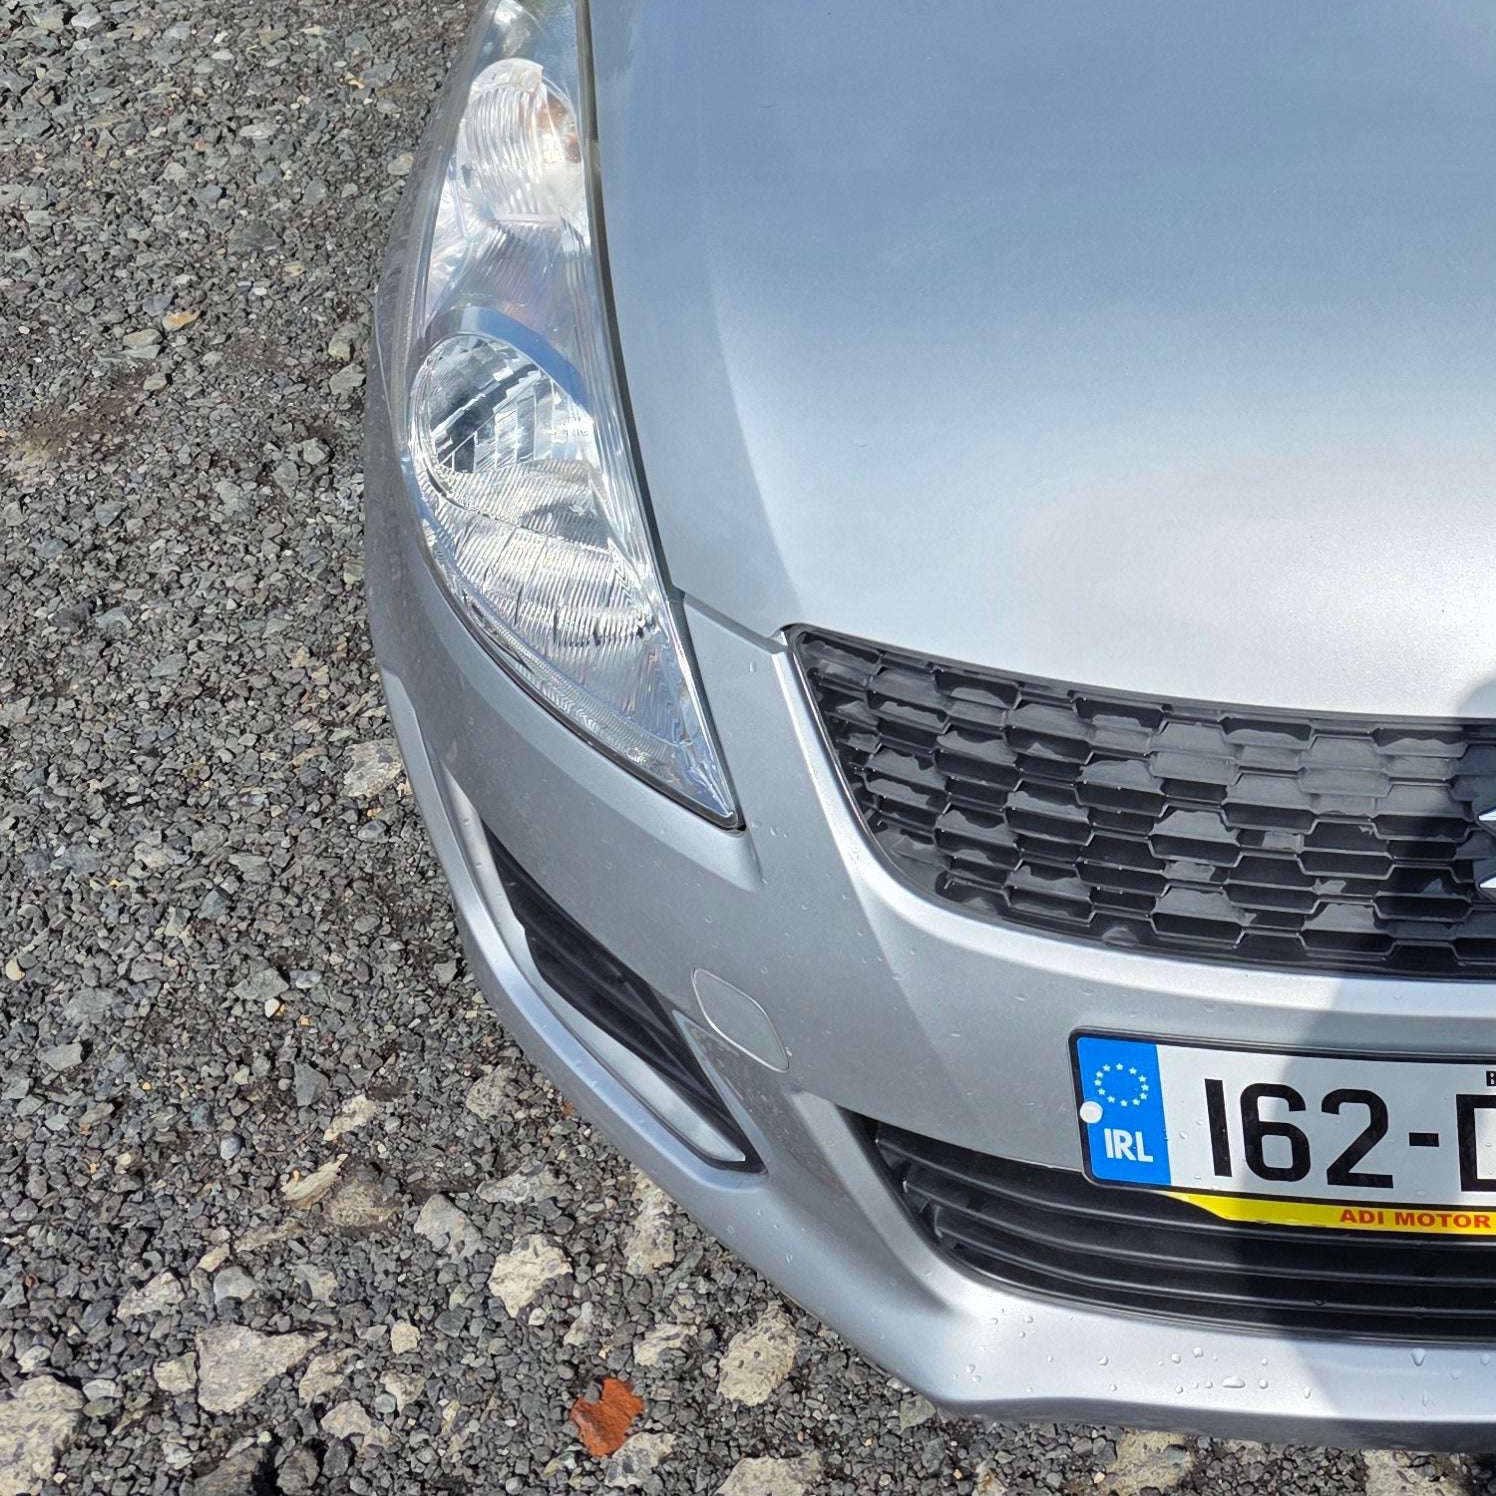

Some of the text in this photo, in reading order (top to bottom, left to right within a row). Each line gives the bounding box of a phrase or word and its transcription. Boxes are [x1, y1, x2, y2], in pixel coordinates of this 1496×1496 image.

[1104, 1128, 1154, 1163] IRL
[1340, 1208, 1386, 1225] ADI
[1395, 1212, 1492, 1229] MOTOR
